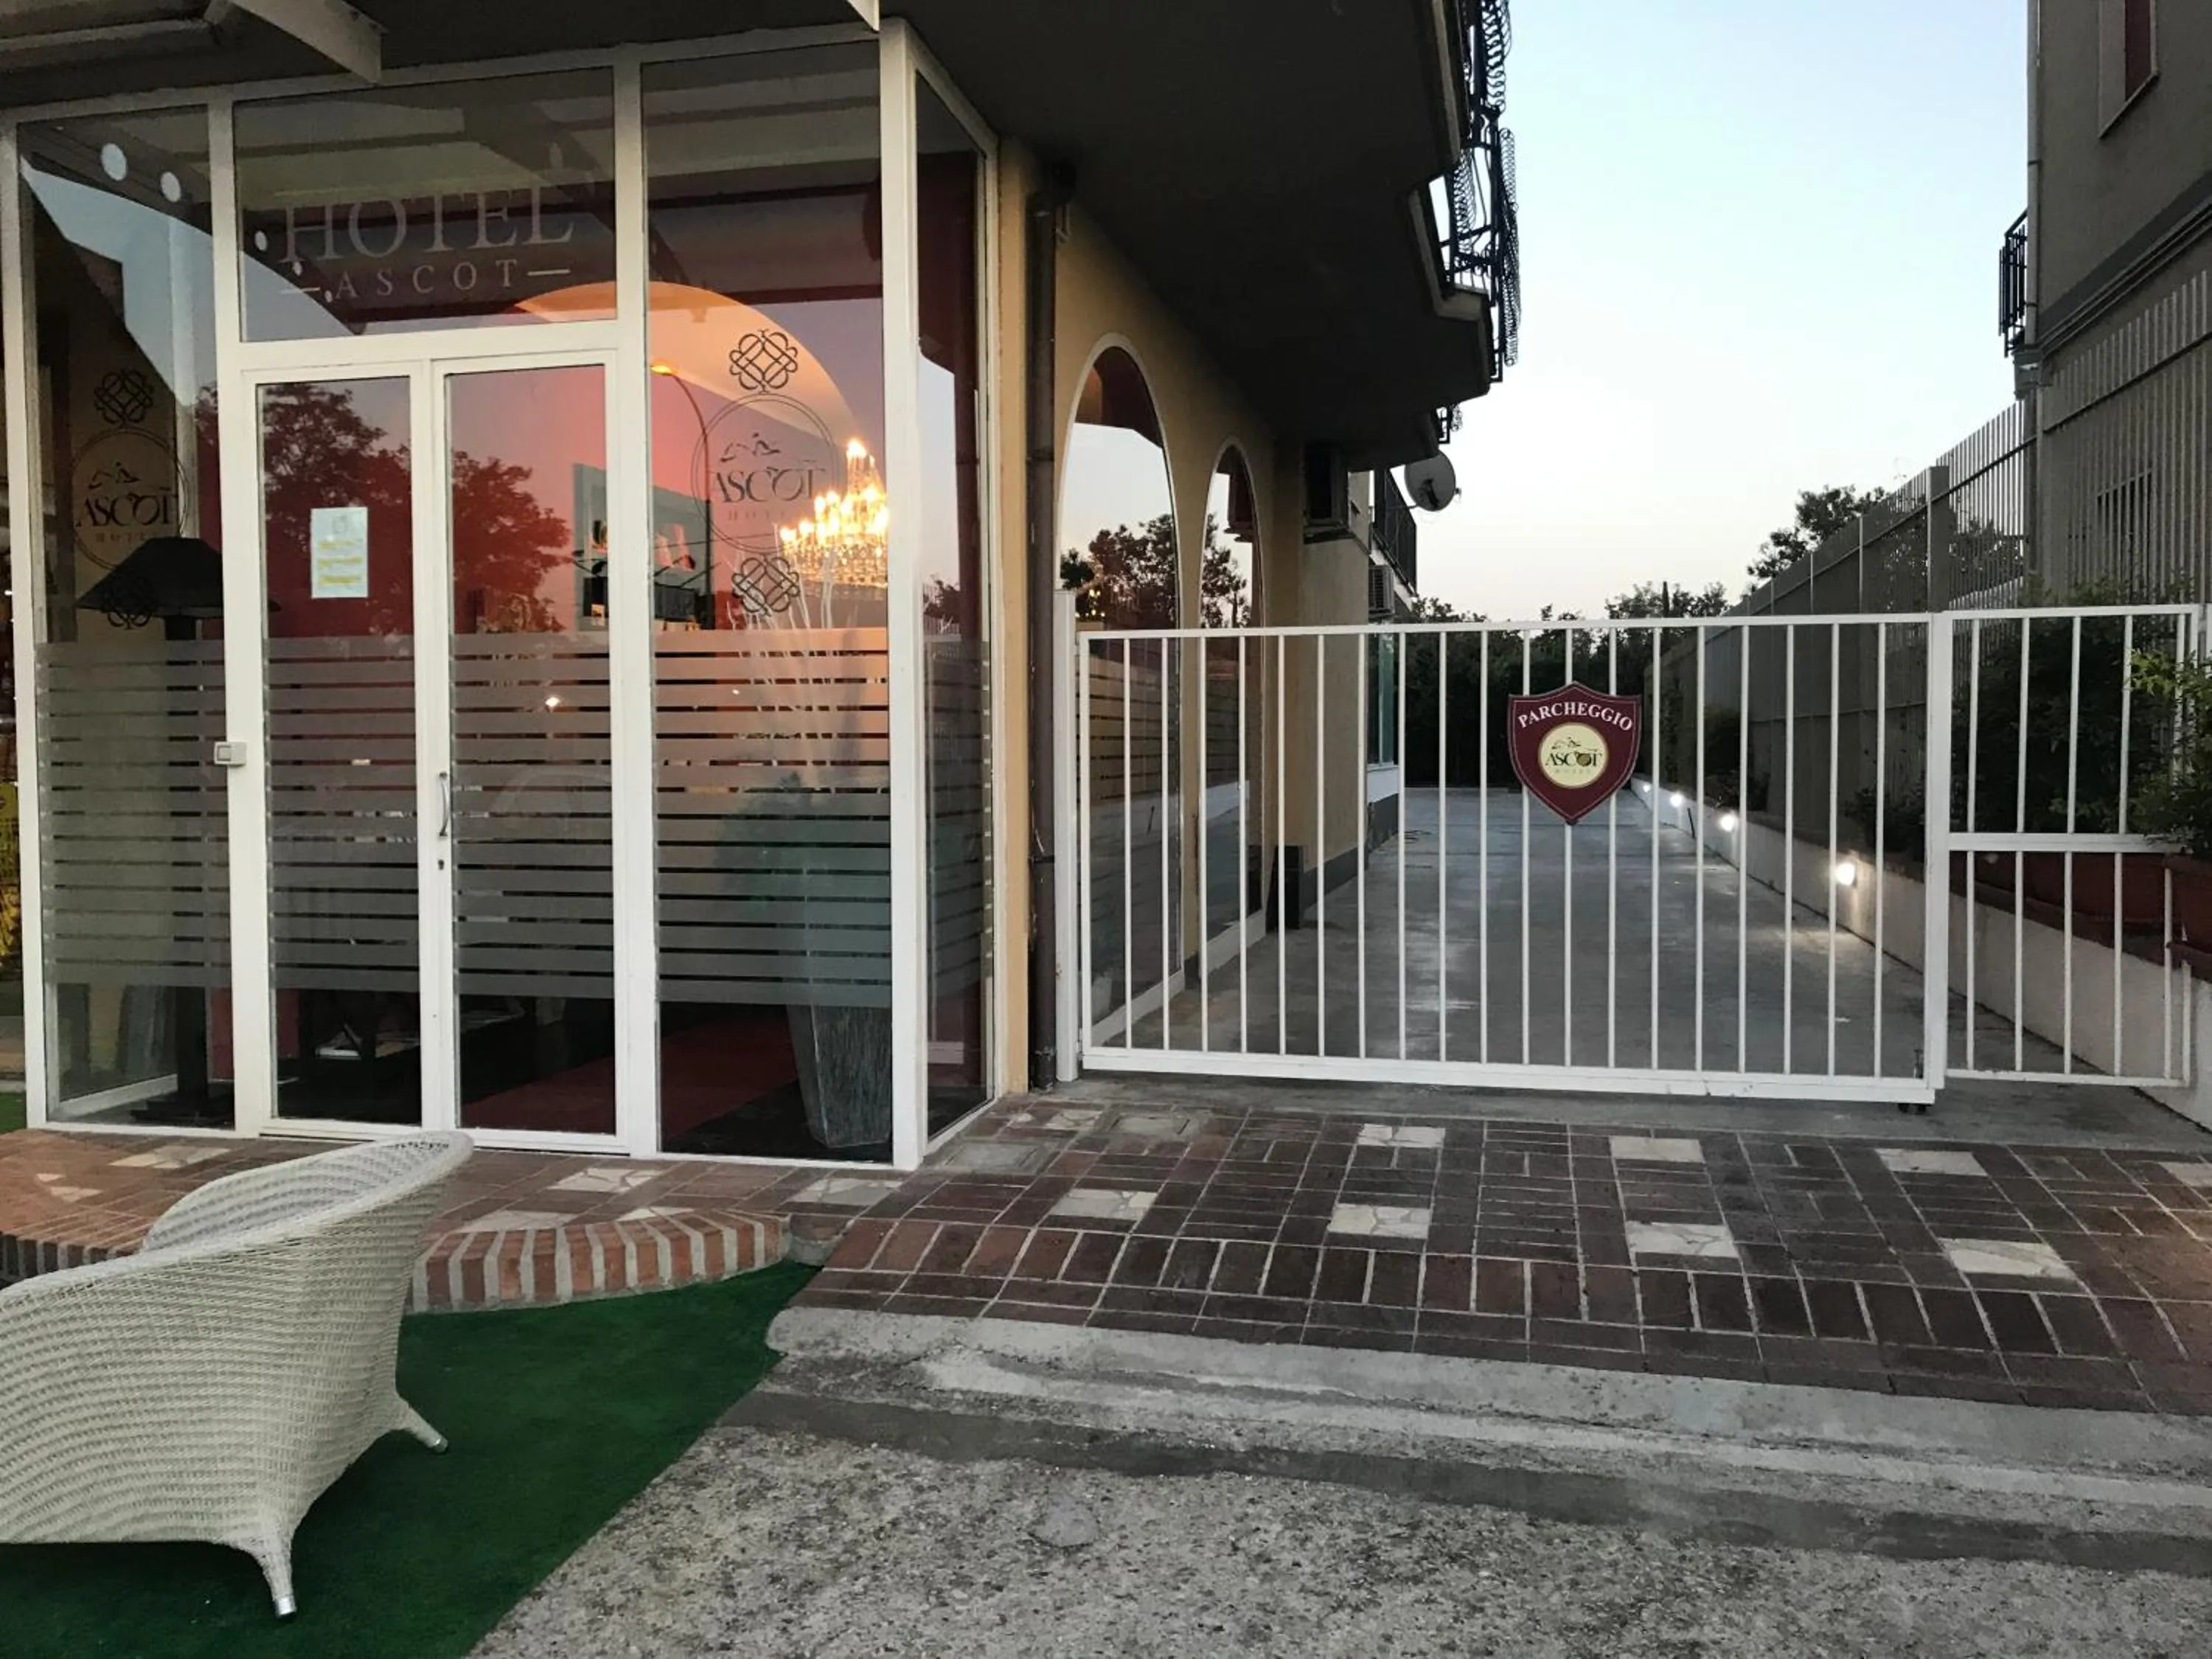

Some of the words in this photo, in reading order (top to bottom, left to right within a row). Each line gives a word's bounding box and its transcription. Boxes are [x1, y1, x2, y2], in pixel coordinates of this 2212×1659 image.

[276, 184, 575, 264] HOTEL
[335, 258, 519, 299] ASCOT
[712, 466, 826, 504] ASCOT
[75, 491, 177, 528] ASCOT
[1517, 701, 1633, 731] PARCHEGGIO
[1545, 751, 1603, 768] ASCOT
